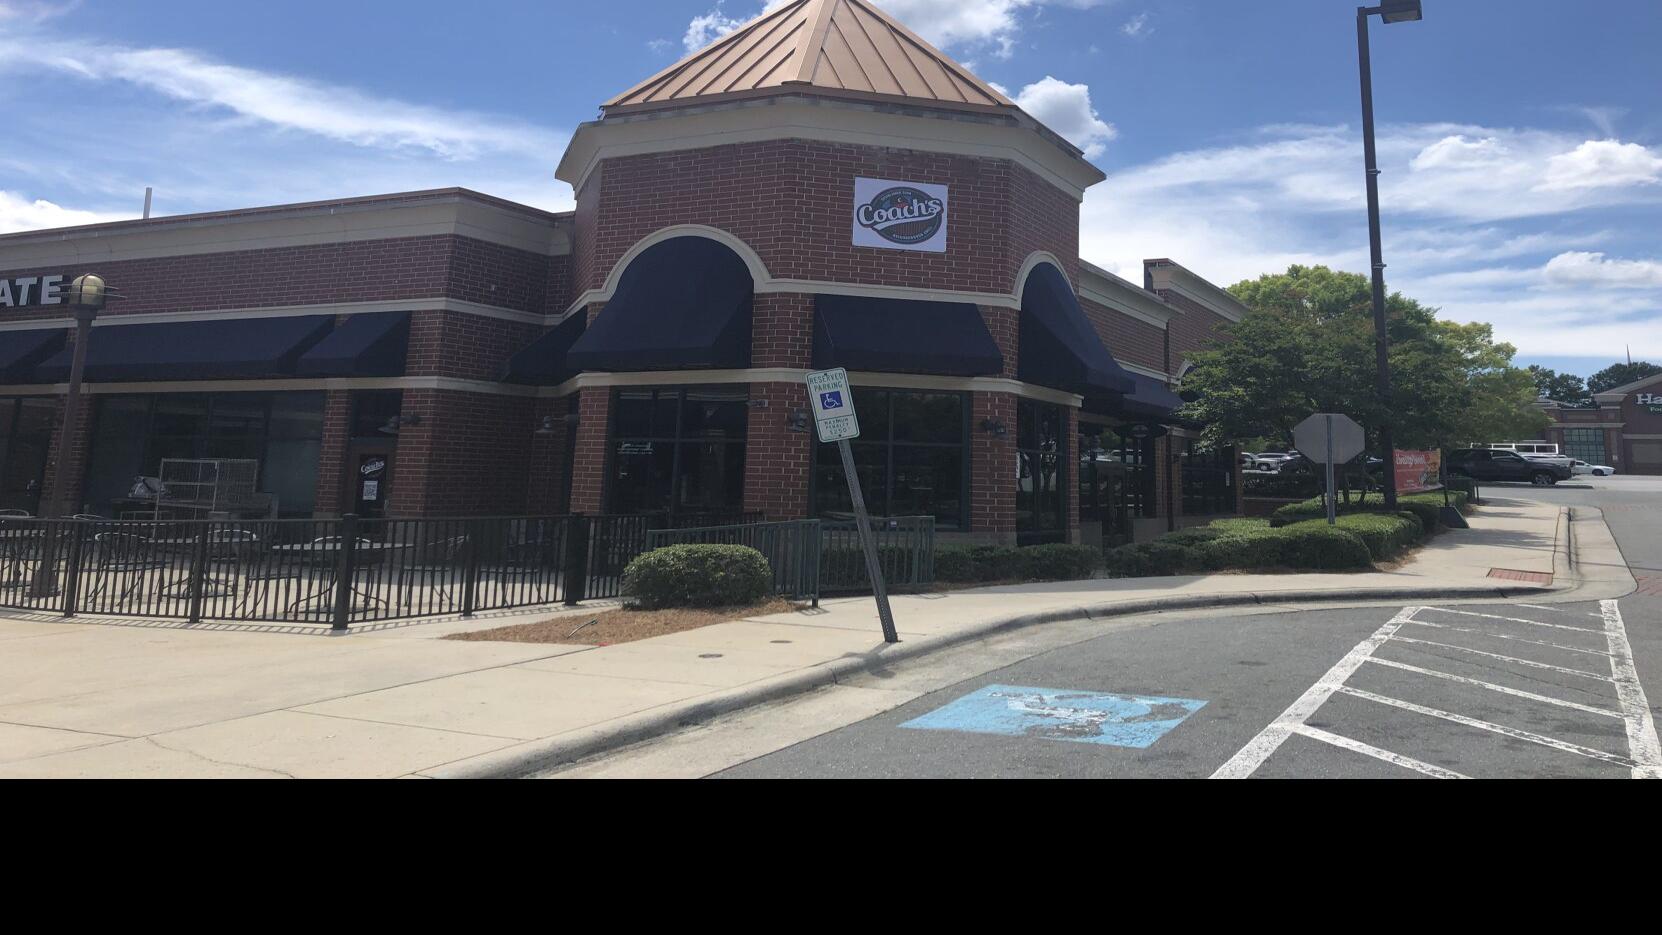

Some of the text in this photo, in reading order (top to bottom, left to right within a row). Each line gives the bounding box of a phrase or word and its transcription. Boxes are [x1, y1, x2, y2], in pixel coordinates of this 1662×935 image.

[858, 198, 942, 226] Coach's
[0, 275, 63, 307] ATE
[809, 372, 844, 385] RESERVED
[813, 381, 843, 392] PARKING
[824, 417, 849, 425] MAXIMUM
